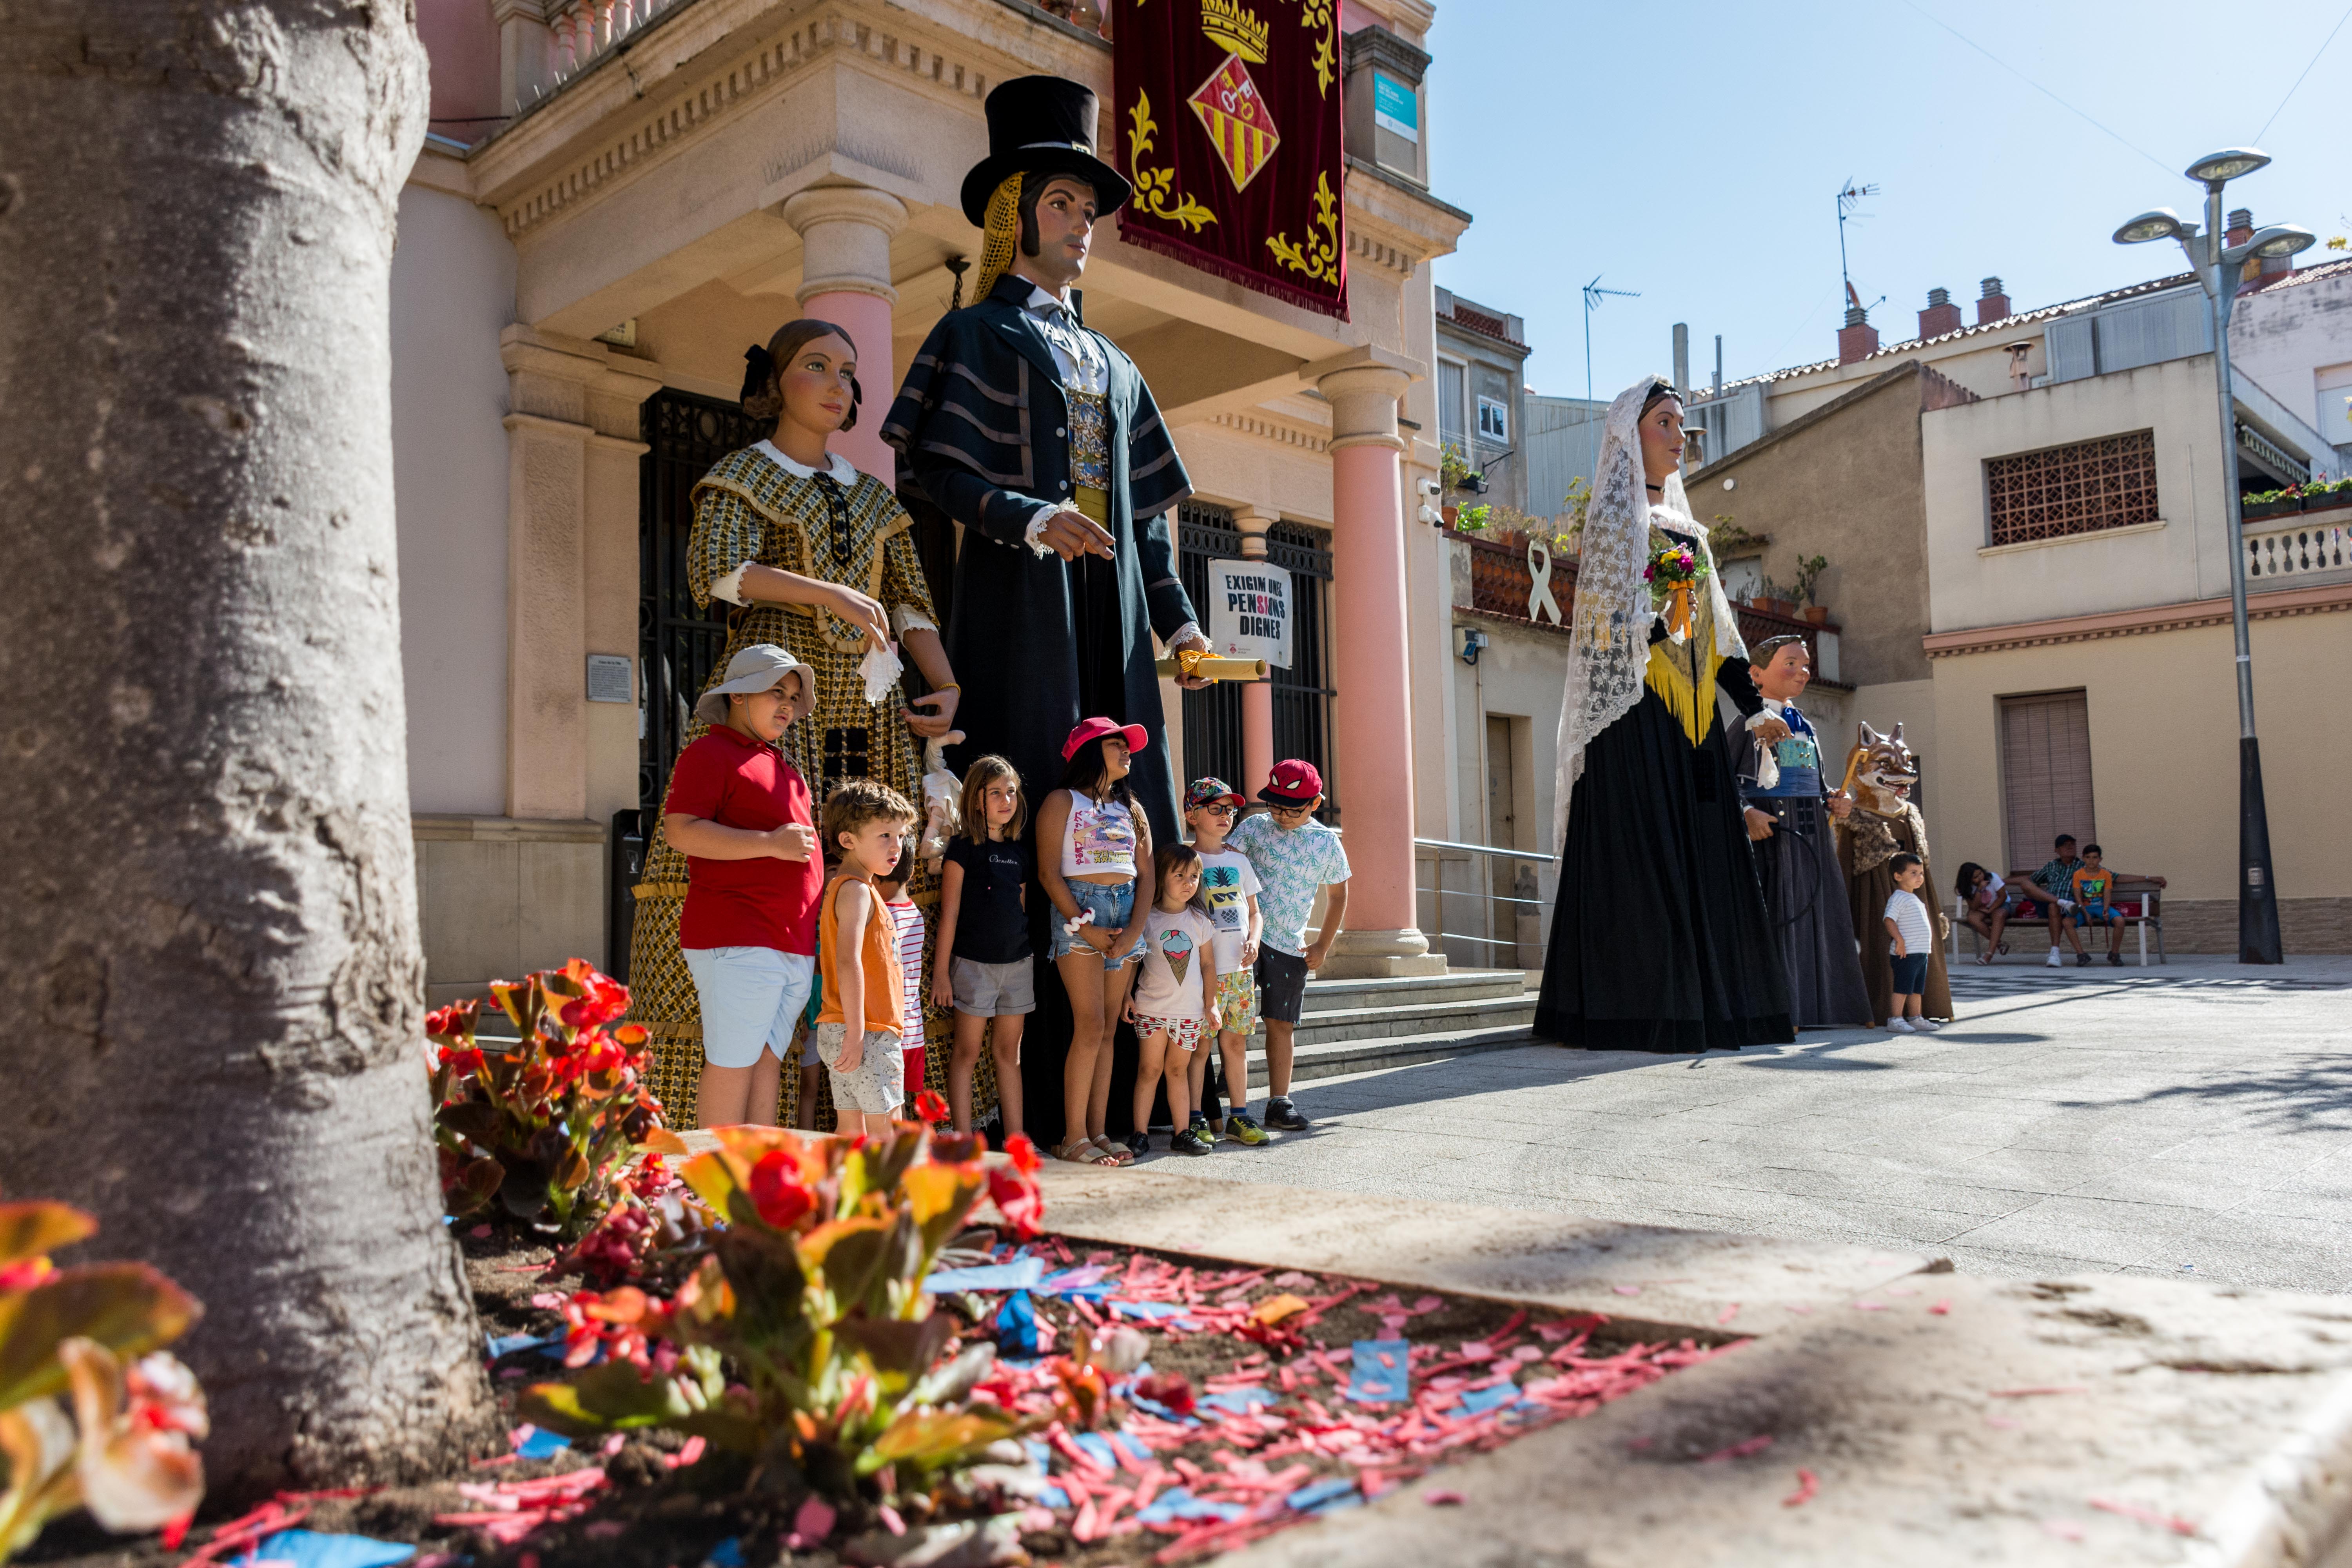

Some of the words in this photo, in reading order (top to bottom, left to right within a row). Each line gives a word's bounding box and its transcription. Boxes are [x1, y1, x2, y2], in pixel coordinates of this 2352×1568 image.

[1225, 575, 1266, 592] EXIGIM
[1269, 579, 1282, 597] UNES
[1228, 593, 1285, 619] PENSIONS
[1240, 615, 1280, 640] DIGNES
